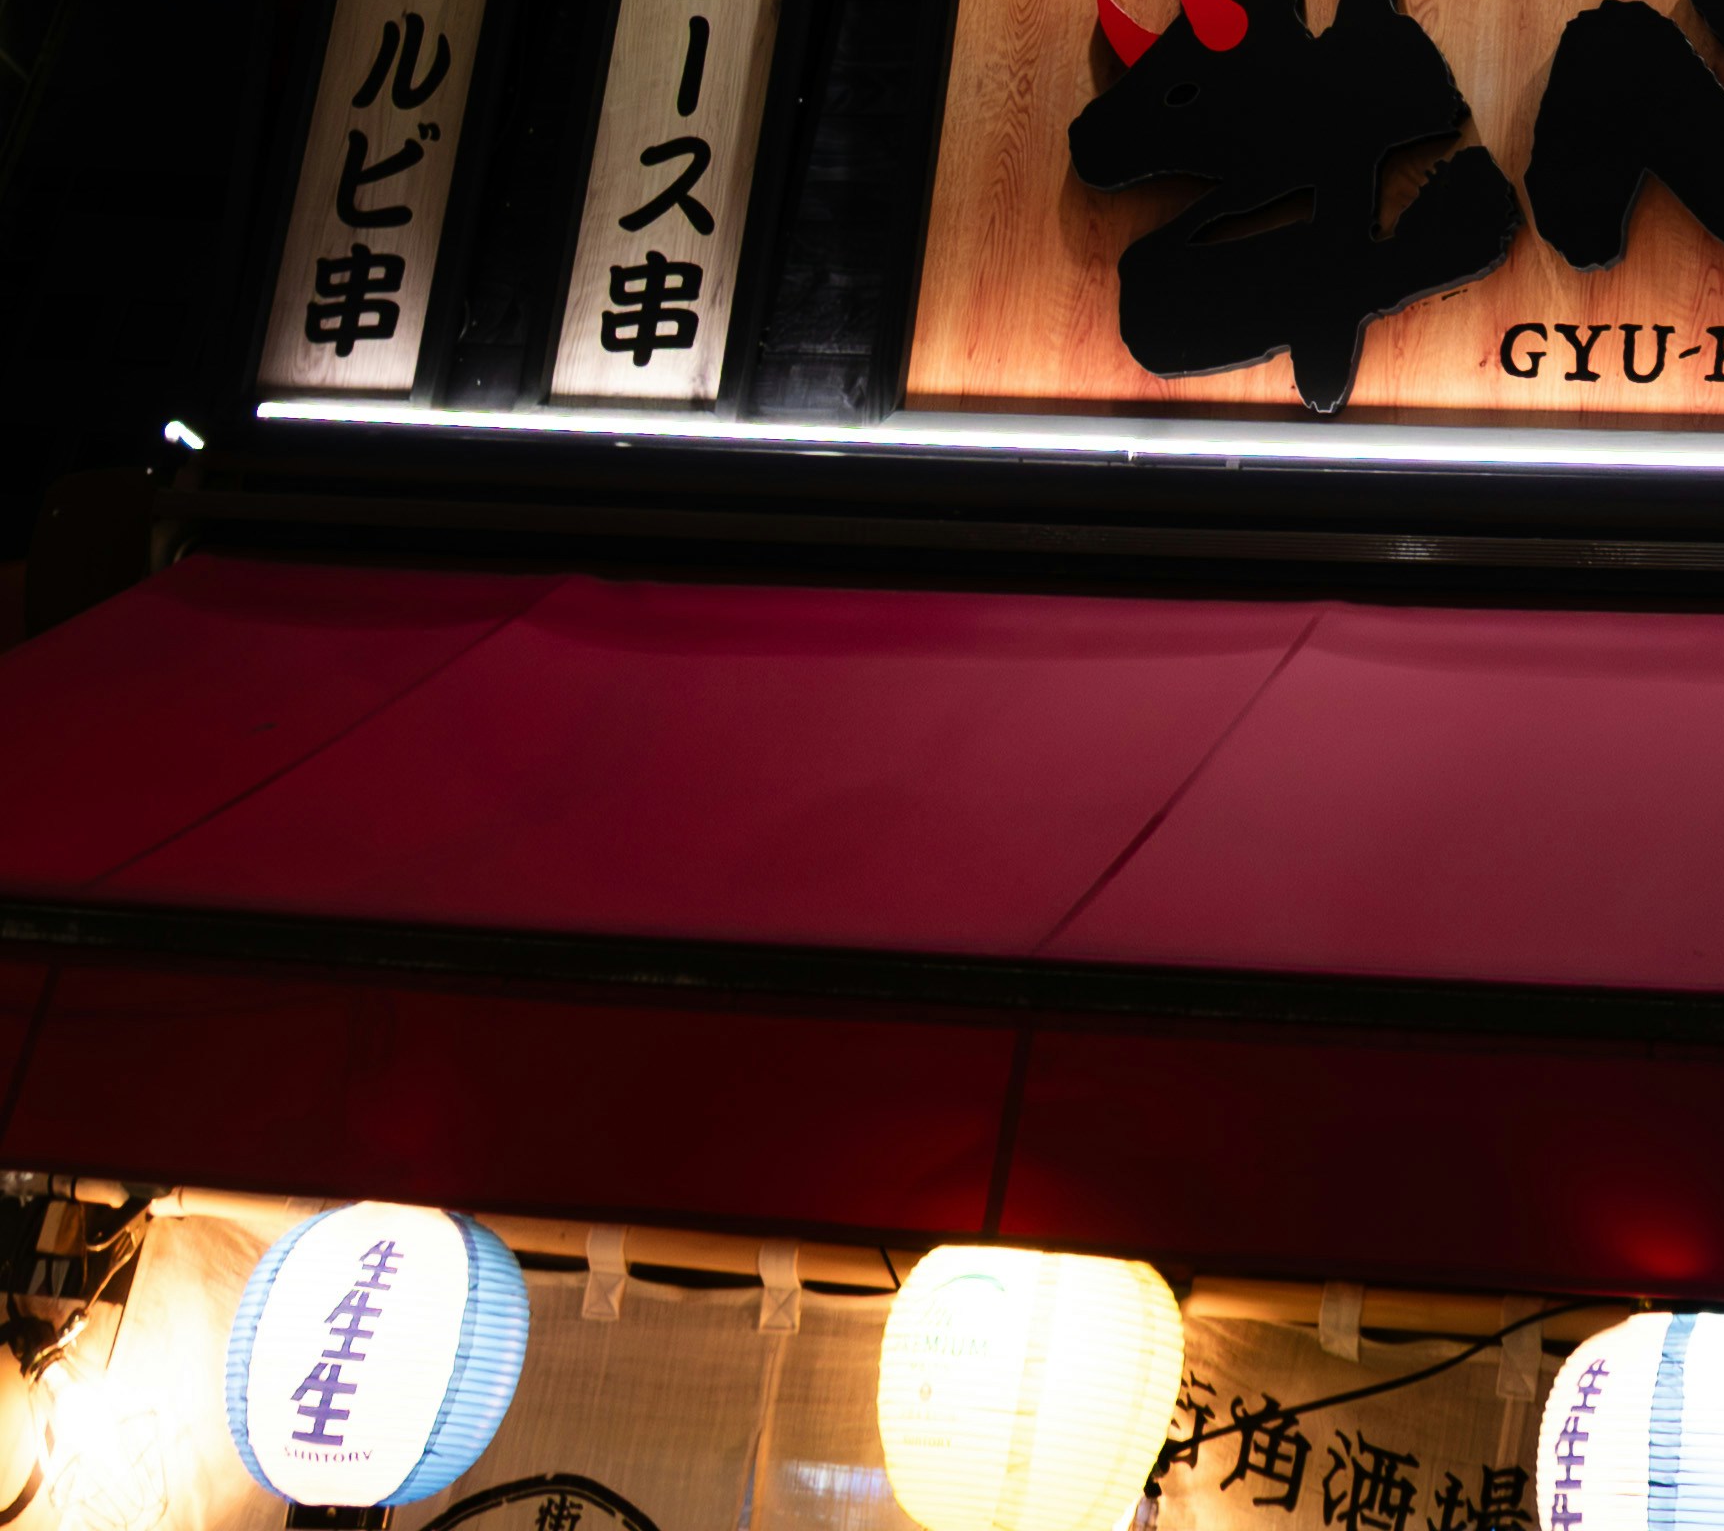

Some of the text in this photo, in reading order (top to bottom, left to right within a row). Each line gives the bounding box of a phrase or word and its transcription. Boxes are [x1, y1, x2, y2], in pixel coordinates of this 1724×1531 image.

[290, 1238, 406, 1448] 生生生
[889, 1333, 990, 1358] REMIUM
[282, 1443, 375, 1465] SUNTORY
